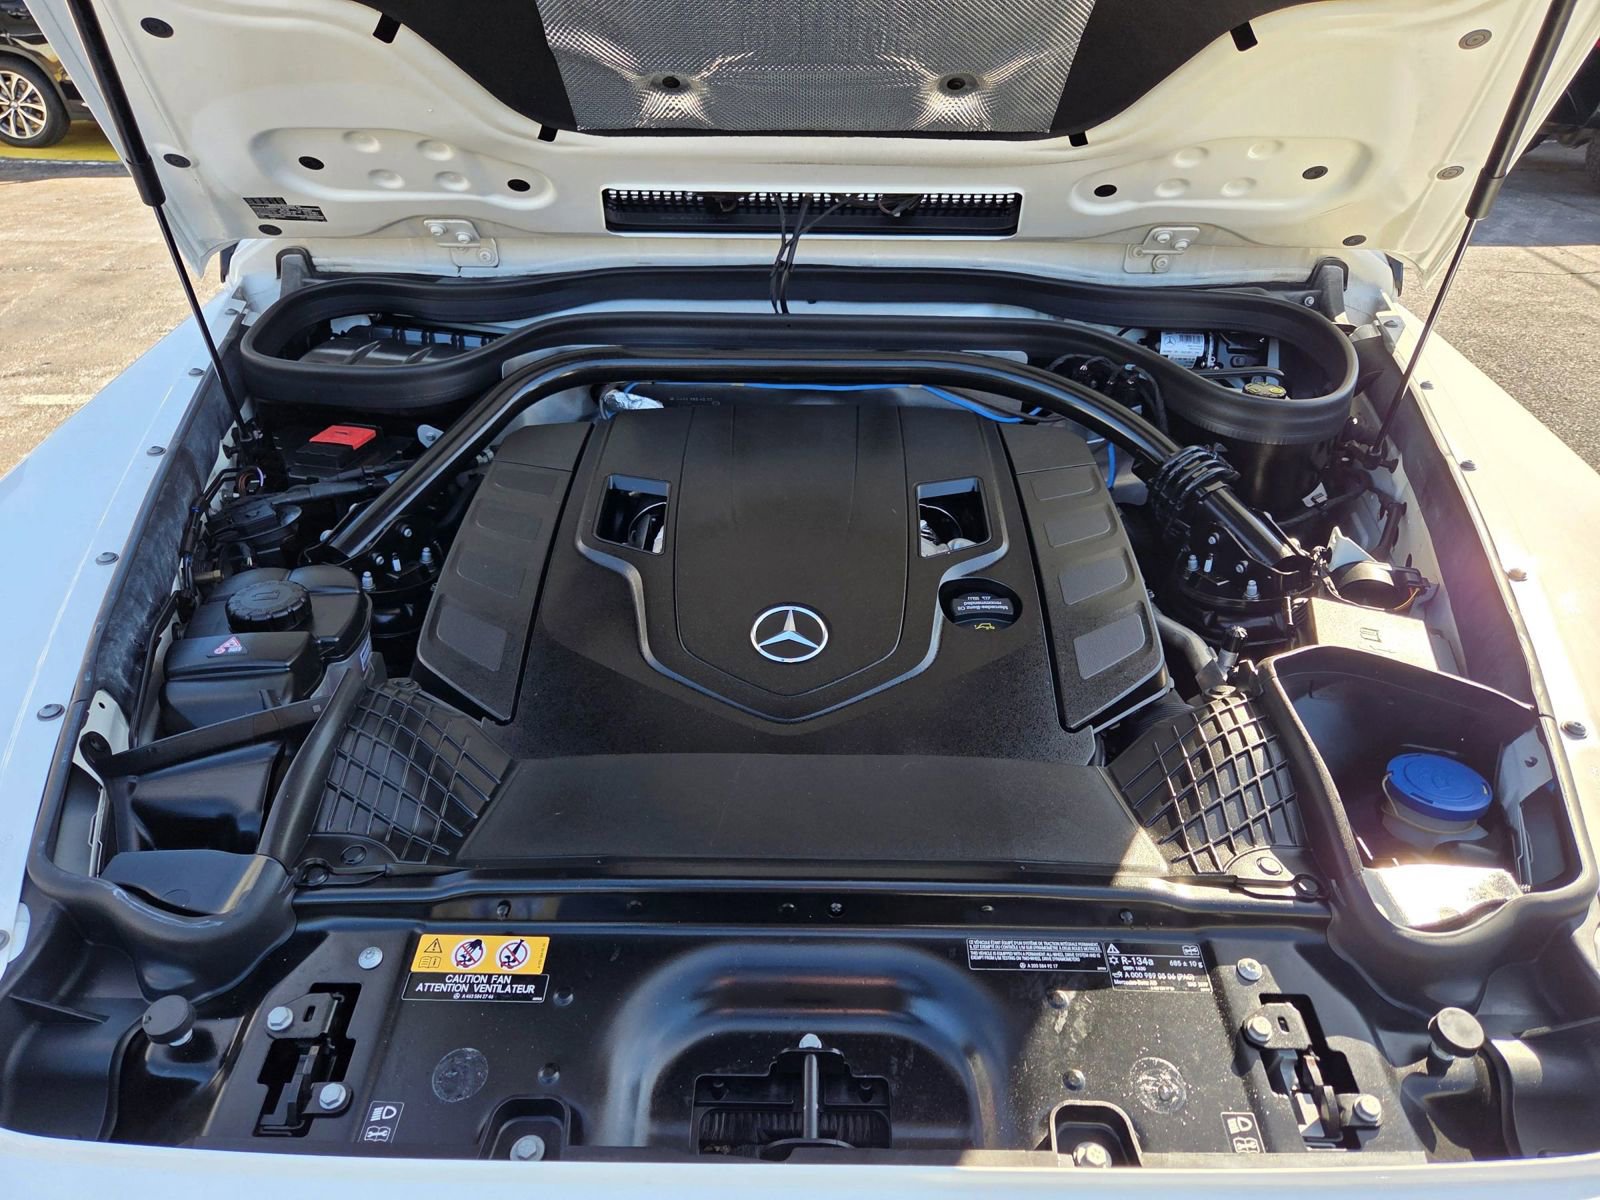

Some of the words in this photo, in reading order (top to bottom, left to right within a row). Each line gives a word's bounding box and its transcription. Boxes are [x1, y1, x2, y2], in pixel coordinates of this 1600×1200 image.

[1121, 956, 1154, 966] R-134a
[445, 974, 488, 984] CAUTION
[490, 975, 512, 984] FAN
[416, 982, 470, 992] ATTENTION
[473, 984, 536, 994] VENTILATEUR
